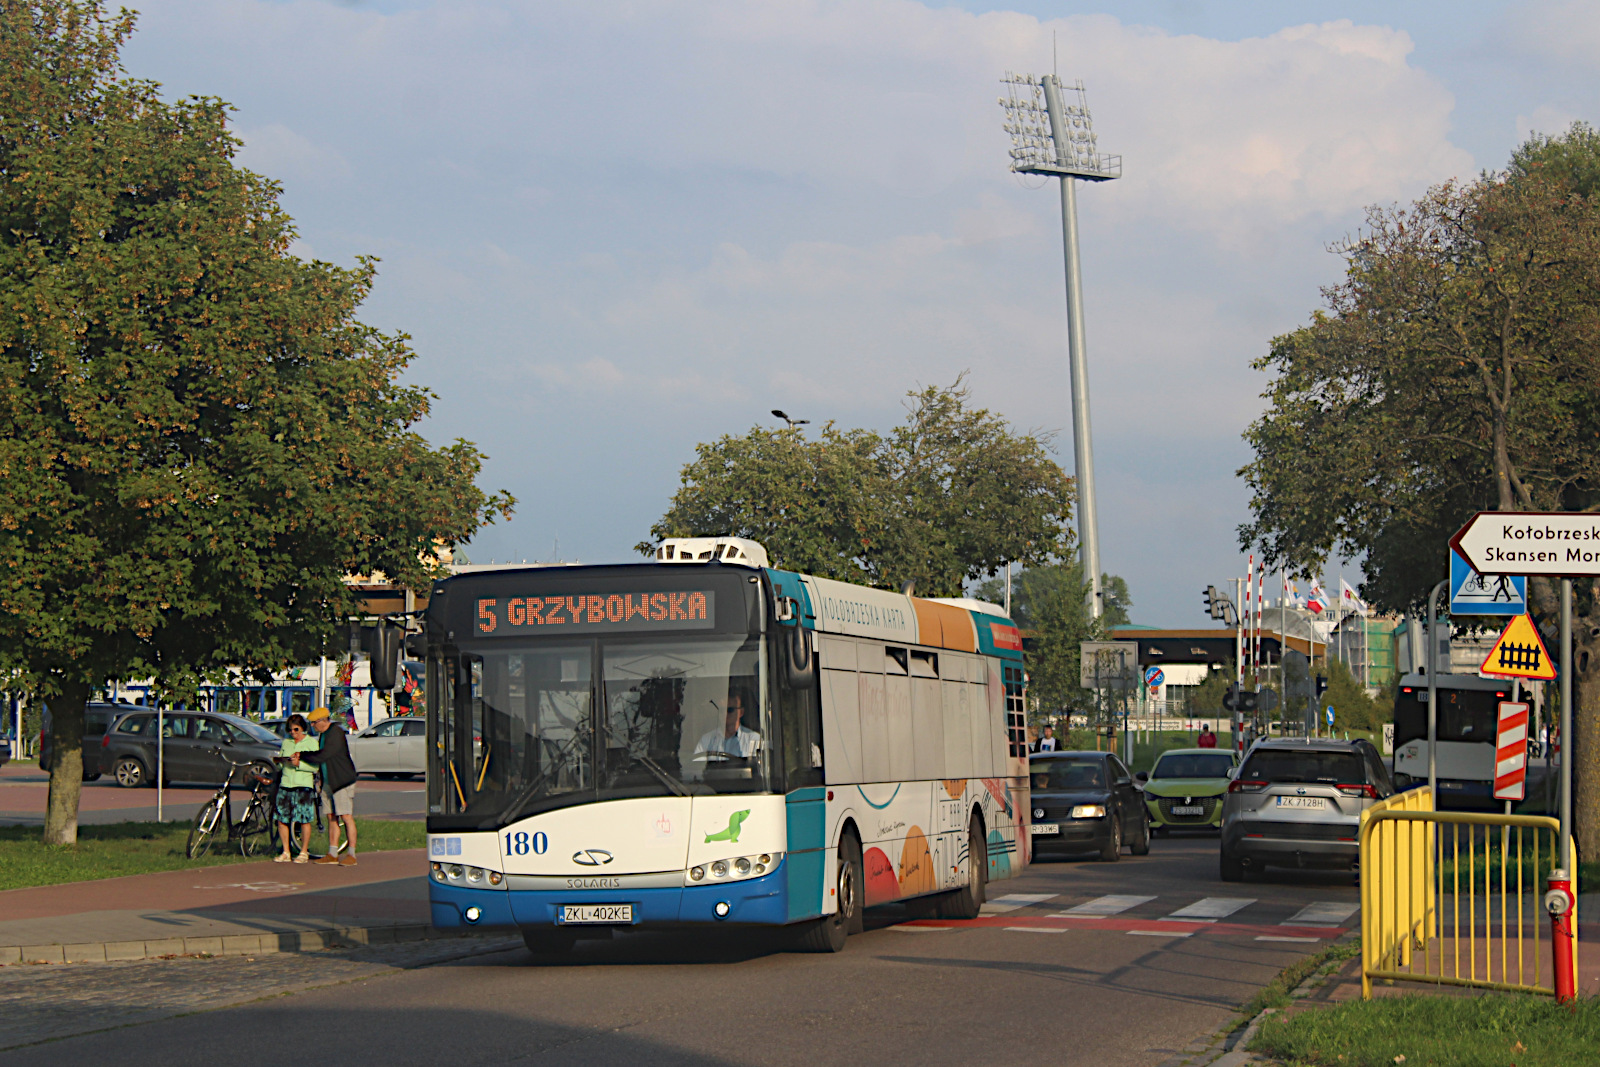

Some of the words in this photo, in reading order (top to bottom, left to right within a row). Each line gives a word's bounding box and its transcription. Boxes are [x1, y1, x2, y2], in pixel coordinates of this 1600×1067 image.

[1503, 525, 1600, 540] Kołobrzesk
[1485, 547, 1557, 562] Skansen
[479, 599, 496, 633] 5
[507, 592, 707, 626] GRZYBOWSKA
[823, 597, 881, 627] KOŁOBRZESKA
[882, 605, 906, 632] KARTA
[1450, 693, 1457, 704] 2
[1283, 798, 1293, 806] ZK
[1297, 799, 1323, 807] 7128H
[505, 831, 548, 856] 180
[566, 878, 620, 889] SOLARIS
[566, 907, 588, 920] ZKL
[593, 906, 630, 920] 402KE
